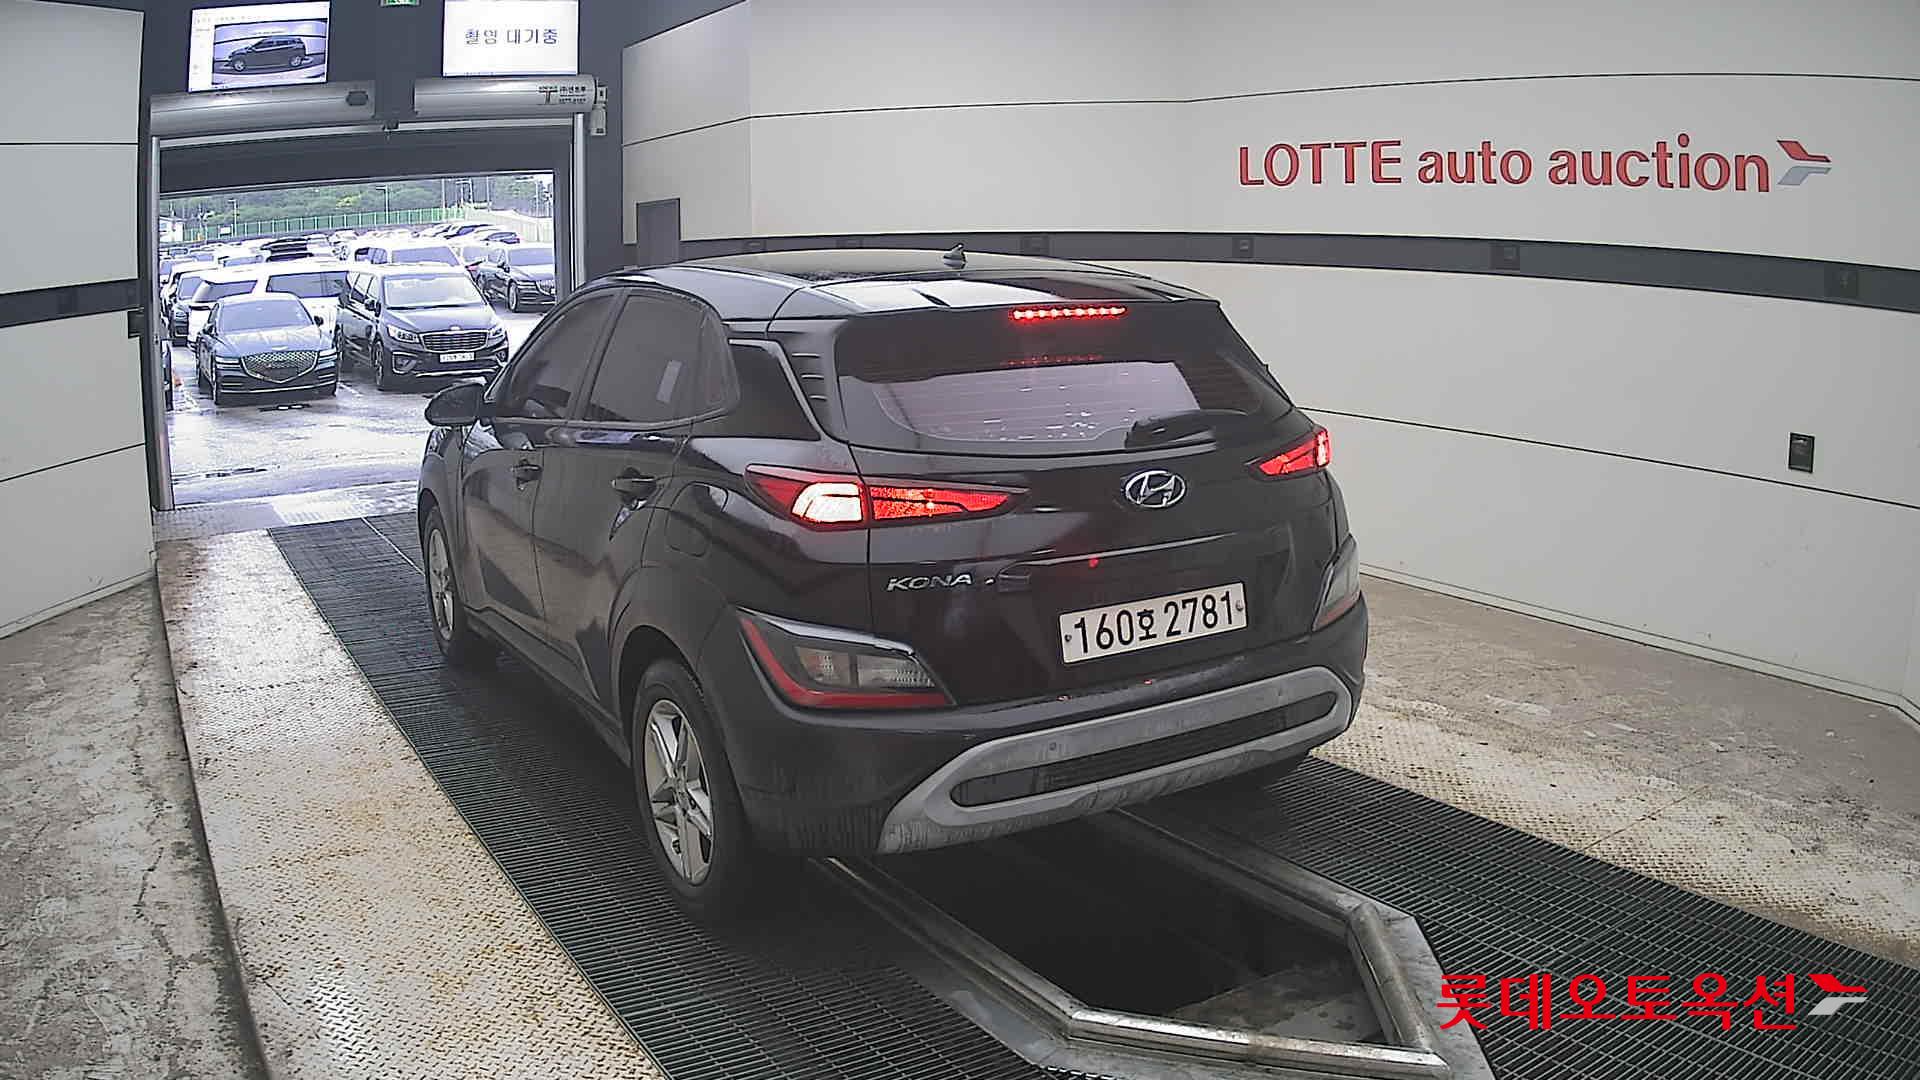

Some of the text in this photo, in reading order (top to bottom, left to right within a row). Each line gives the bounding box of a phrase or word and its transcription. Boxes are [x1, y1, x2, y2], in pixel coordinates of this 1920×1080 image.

[506, 28, 558, 45] 대기중
[1239, 132, 1770, 193] LOTTE auto auction
[886, 573, 972, 592] KONA
